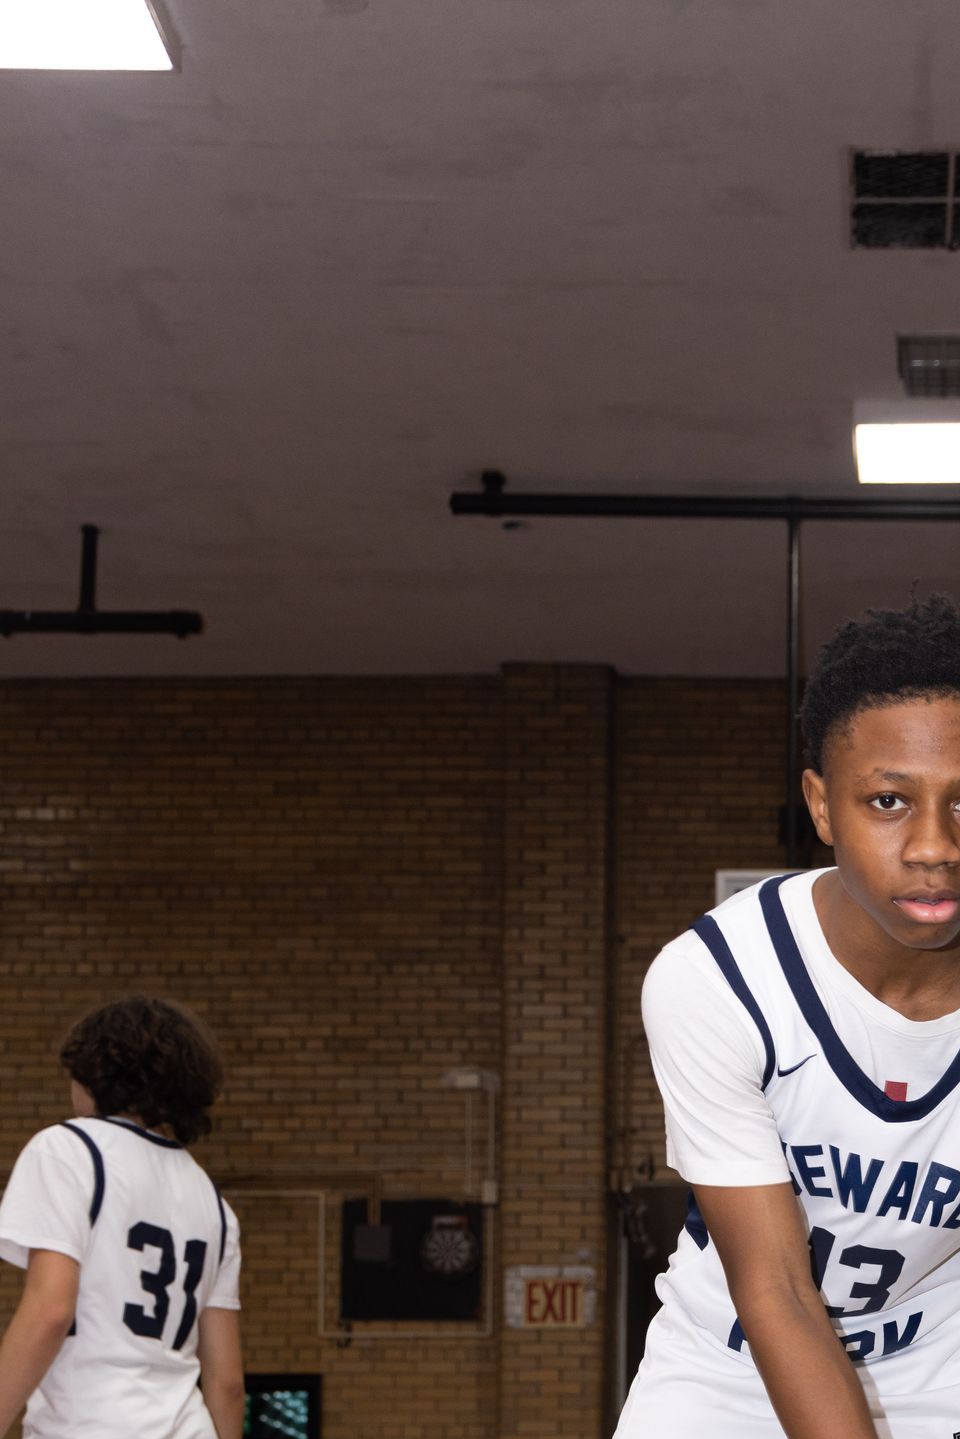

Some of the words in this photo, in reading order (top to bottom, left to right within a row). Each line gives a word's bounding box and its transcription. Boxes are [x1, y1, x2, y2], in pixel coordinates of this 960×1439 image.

[123, 1221, 208, 1351] 31
[526, 1280, 582, 1323] EXIT
[808, 1226, 906, 1319] 13
